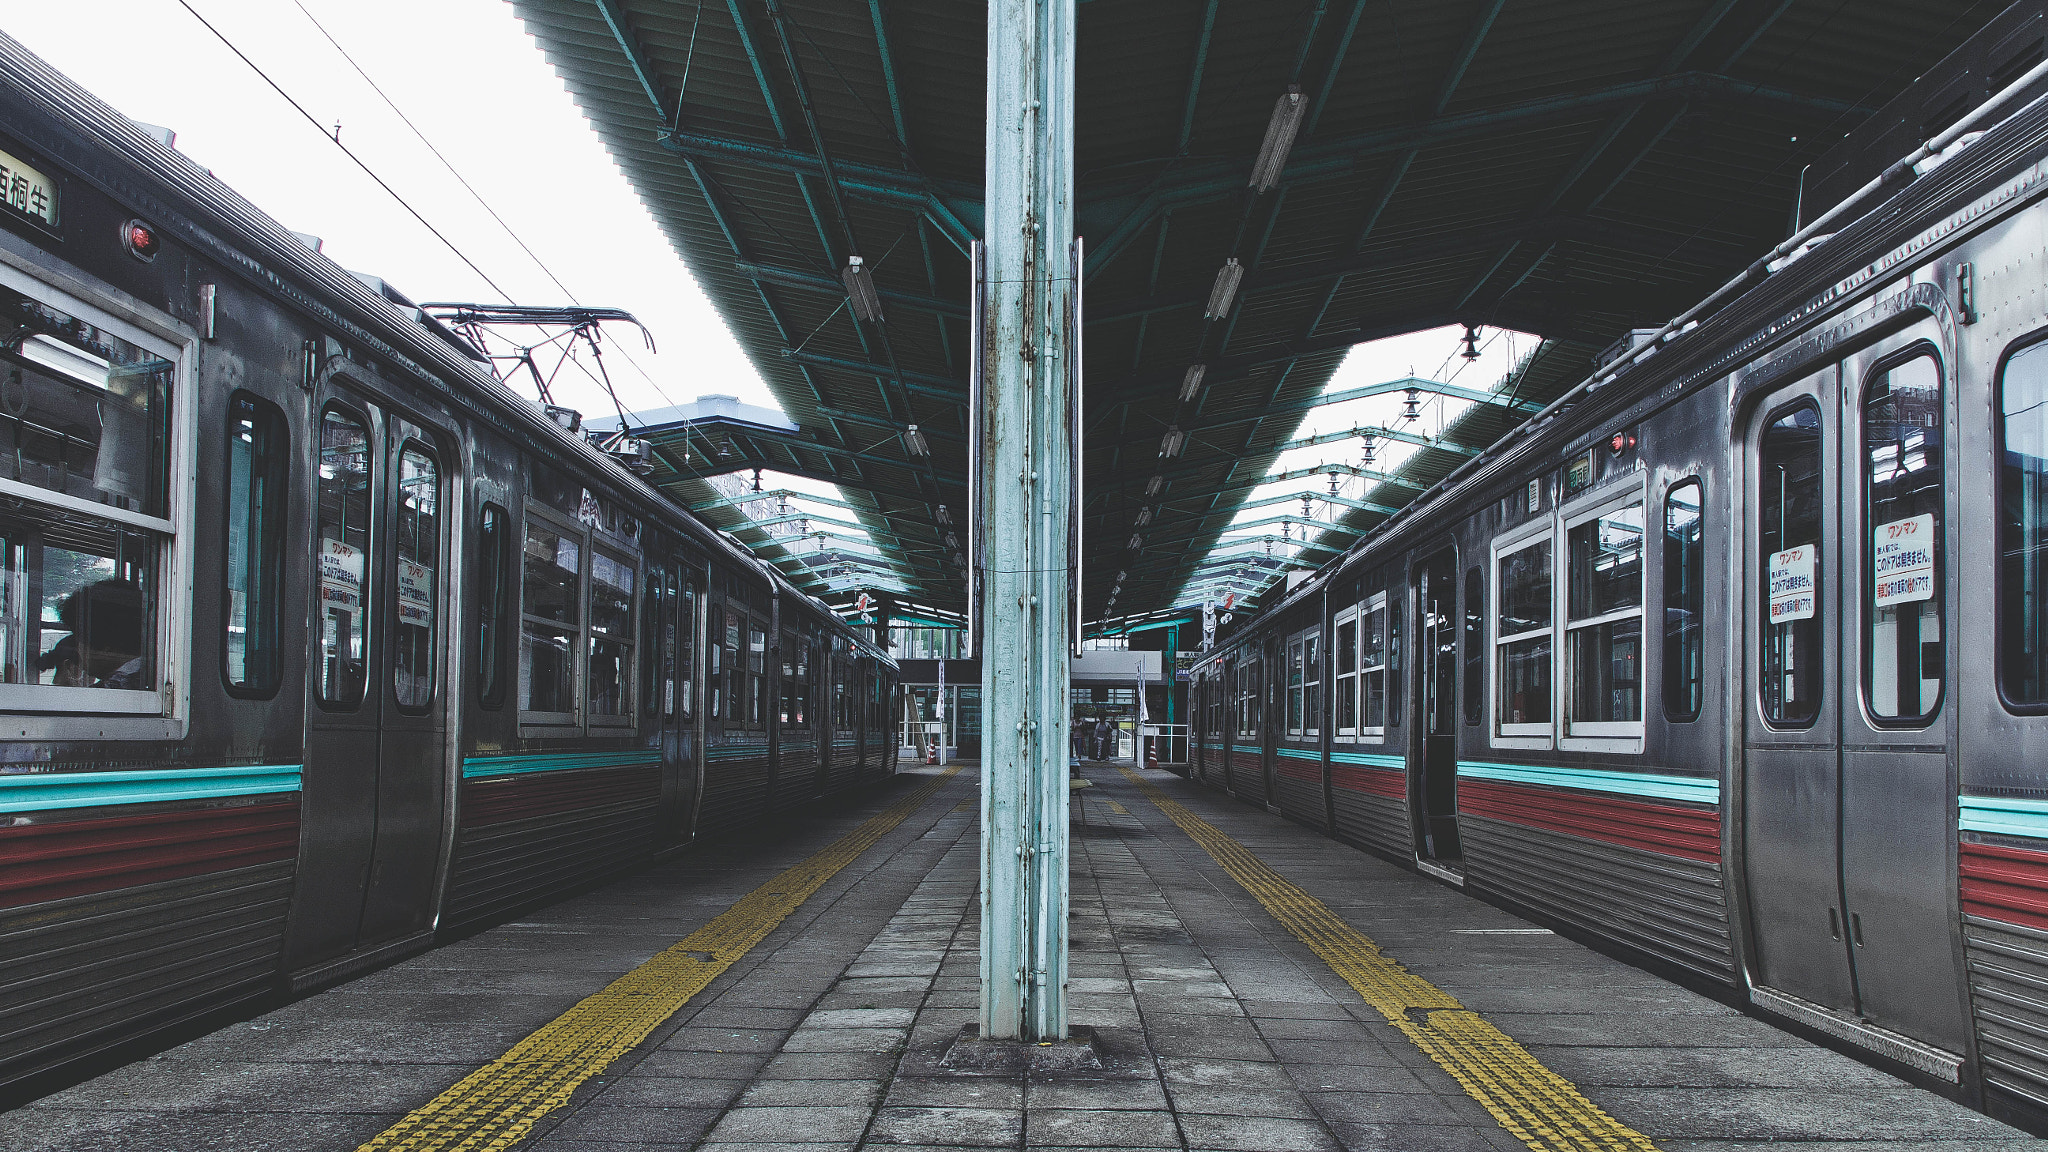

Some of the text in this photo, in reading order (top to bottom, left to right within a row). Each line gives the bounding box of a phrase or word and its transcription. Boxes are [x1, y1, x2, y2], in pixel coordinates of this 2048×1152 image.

[1887, 521, 1918, 539] ワンマン
[332, 543, 353, 558] ワンマン
[1779, 550, 1803, 565] ワンマン
[407, 565, 424, 579] ワンマン
